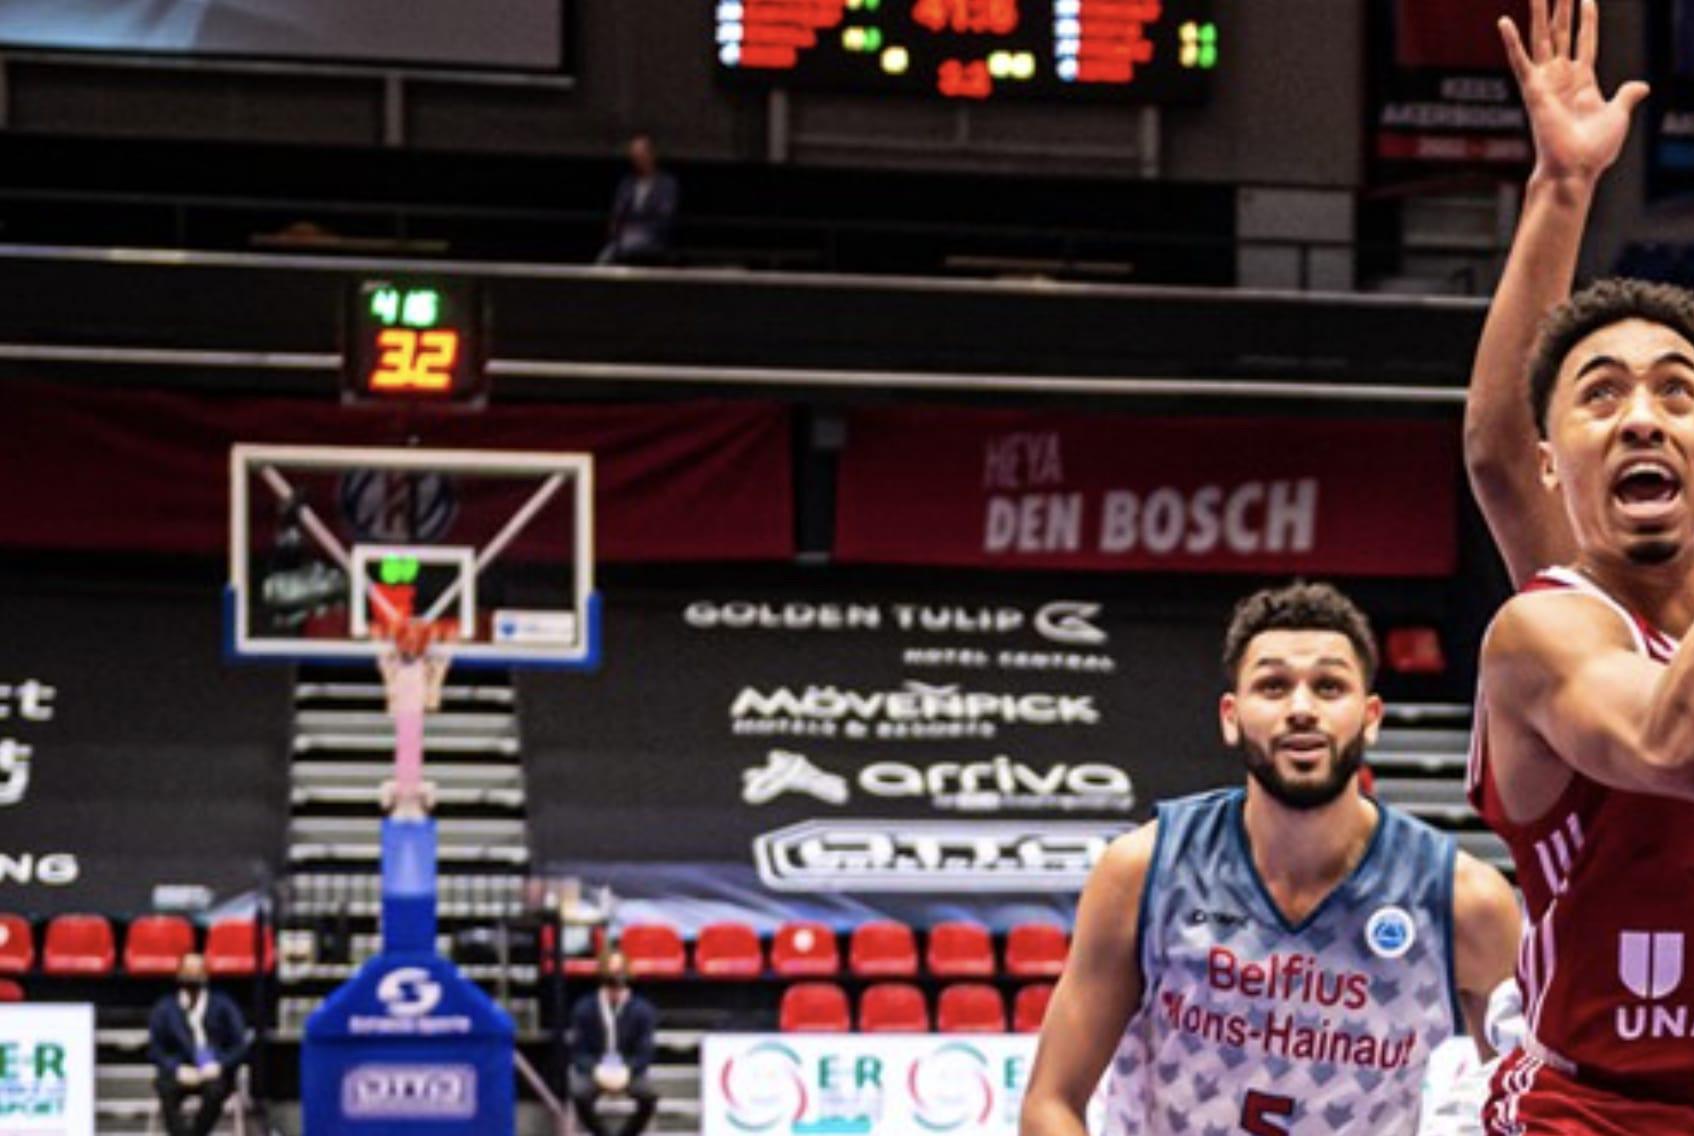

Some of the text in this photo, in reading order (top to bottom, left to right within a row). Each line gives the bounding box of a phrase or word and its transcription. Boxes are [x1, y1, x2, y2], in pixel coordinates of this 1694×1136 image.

[984, 478, 1319, 553] DEN BOSCH
[684, 601, 1025, 632] GOLDEN TULIP
[858, 755, 1134, 796] arriva
[1207, 946, 1369, 1011] Belfius
